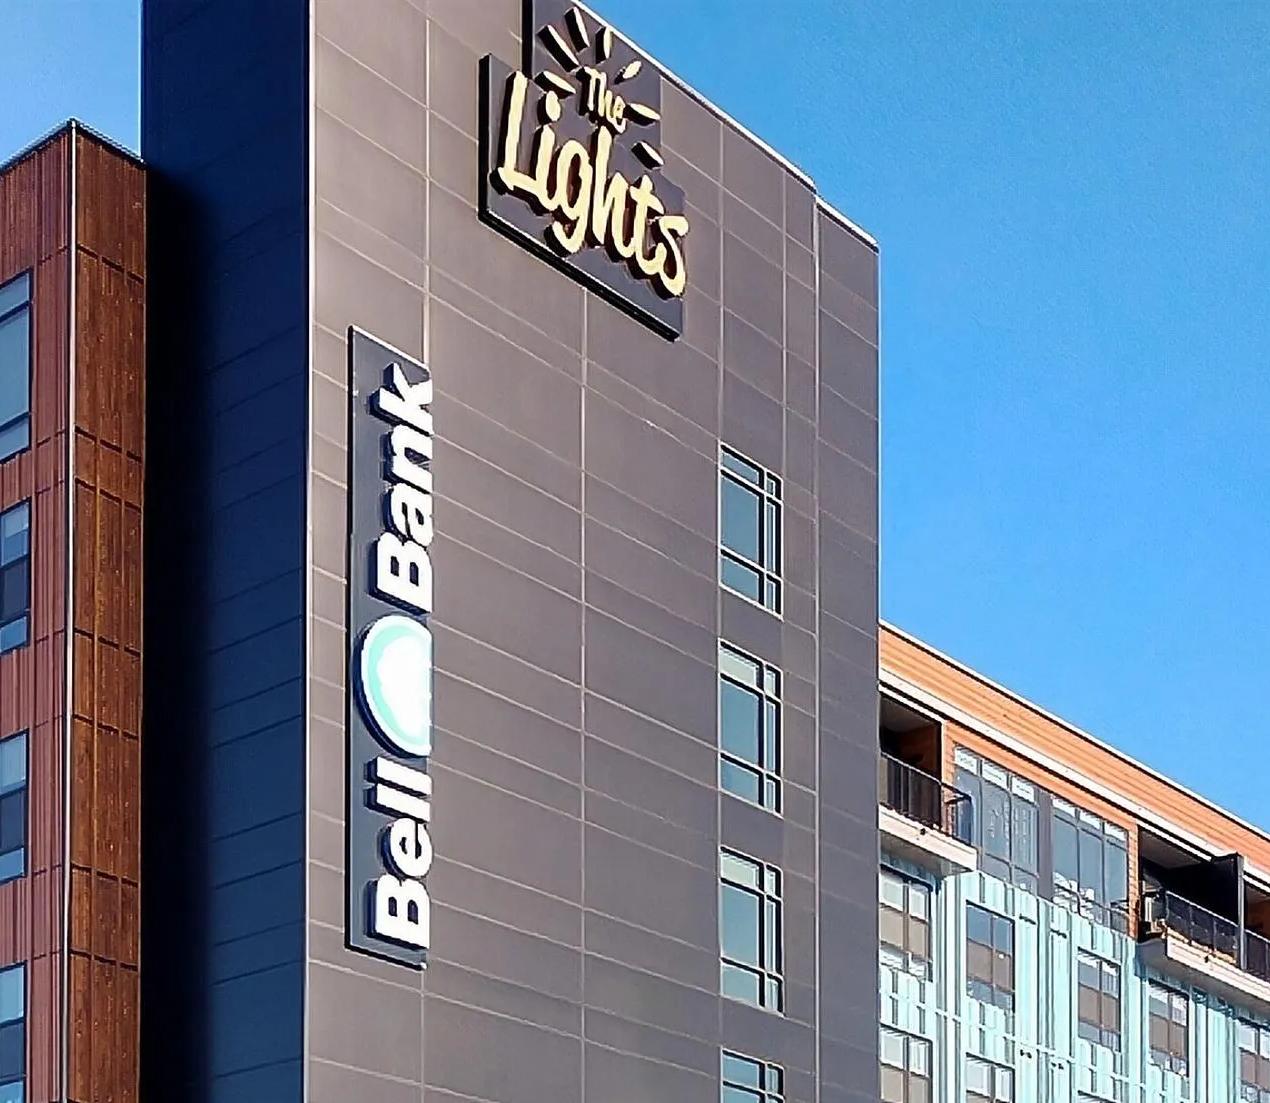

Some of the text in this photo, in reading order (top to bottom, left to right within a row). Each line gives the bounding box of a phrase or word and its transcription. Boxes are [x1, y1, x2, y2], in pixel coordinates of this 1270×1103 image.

[496, 71, 690, 297] Lights
[585, 66, 627, 134] The
[373, 362, 433, 950] Bell Bank
